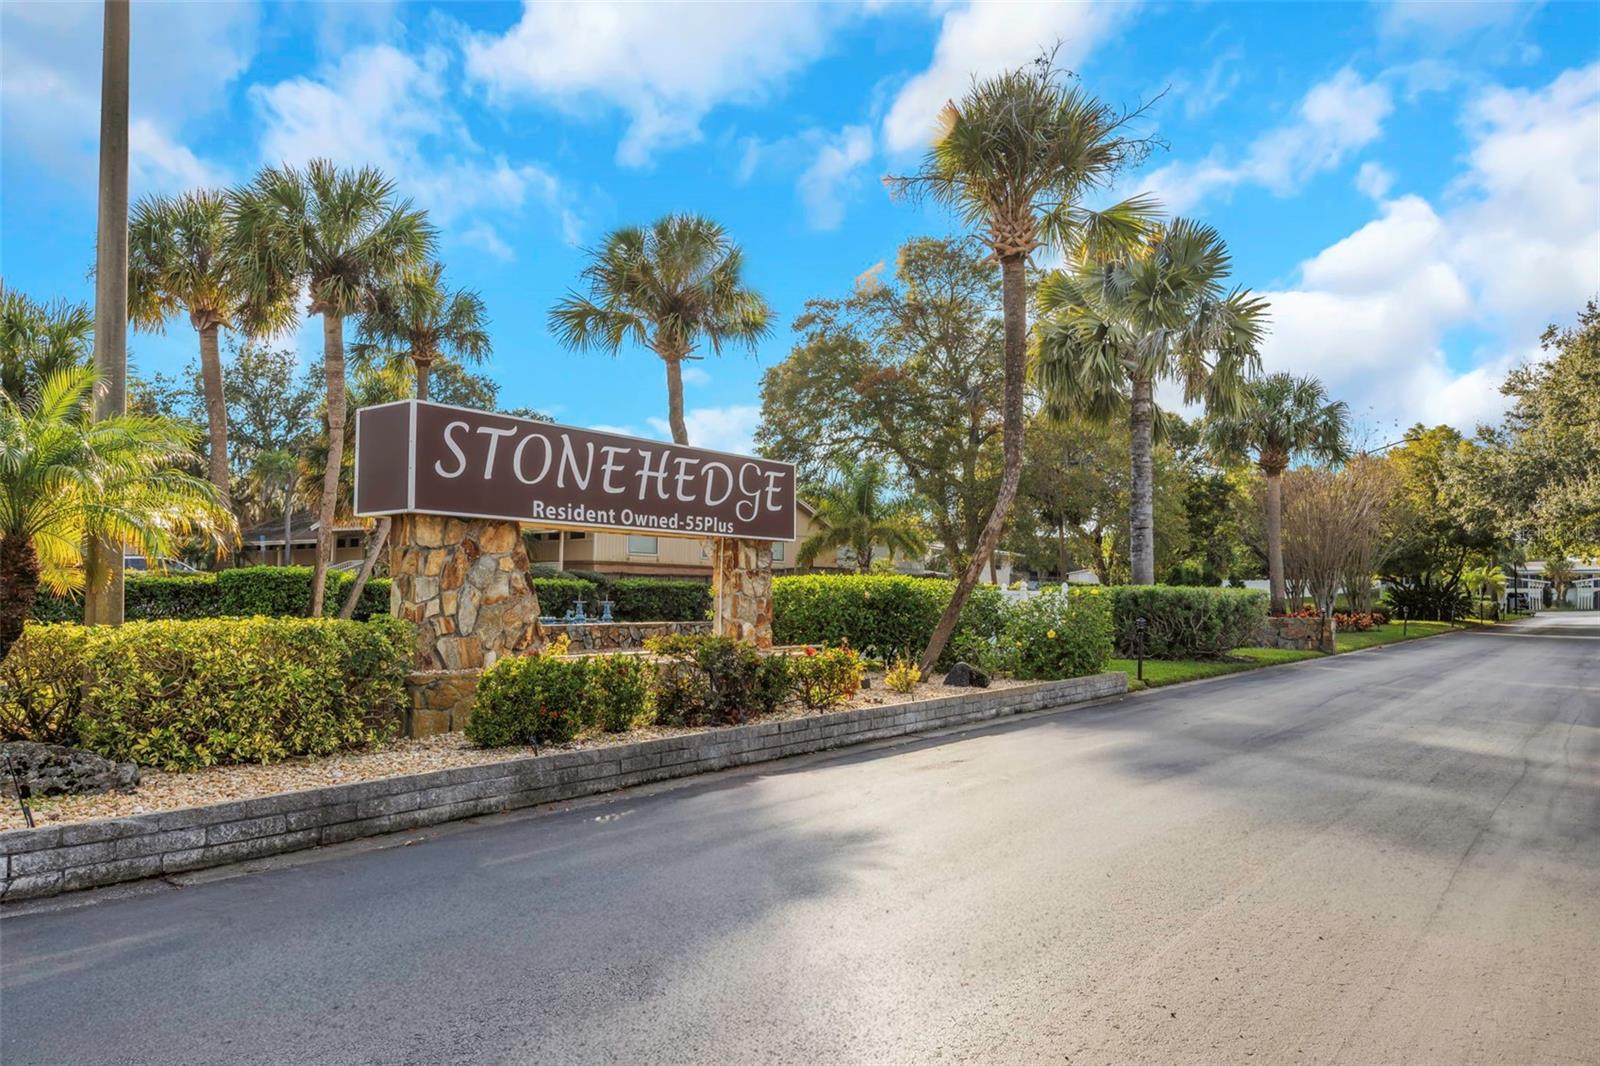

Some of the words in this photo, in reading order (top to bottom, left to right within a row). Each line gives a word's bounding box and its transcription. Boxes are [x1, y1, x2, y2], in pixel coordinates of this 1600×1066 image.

[434, 421, 786, 522] STONEHEDGE
[532, 500, 616, 524] Resident
[620, 508, 734, 534] Owned-55Plus
